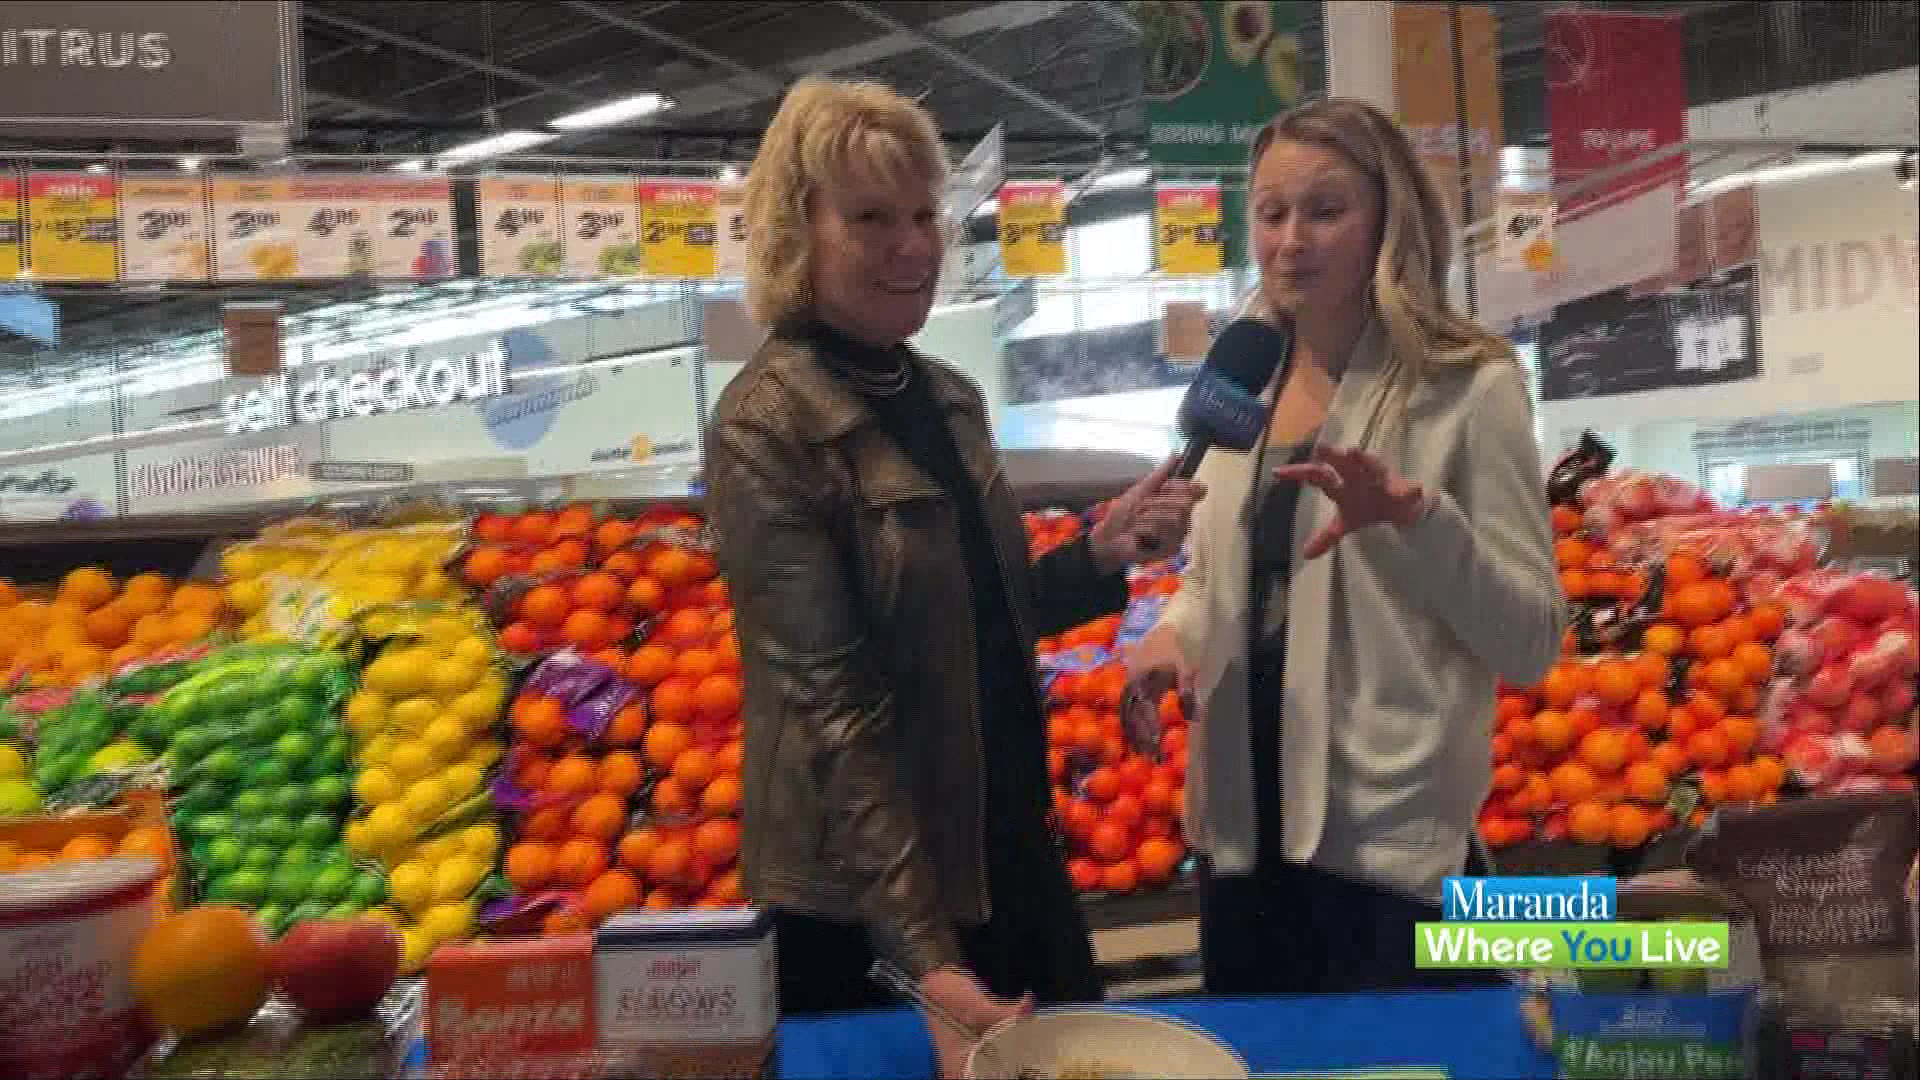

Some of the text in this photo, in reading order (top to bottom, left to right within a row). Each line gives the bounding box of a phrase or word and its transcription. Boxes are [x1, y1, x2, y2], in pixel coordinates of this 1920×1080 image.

[222, 369, 295, 436] self
[296, 334, 510, 425] checkout
[433, 997, 585, 1040] Banza
[617, 984, 737, 1019] ELBOWS
